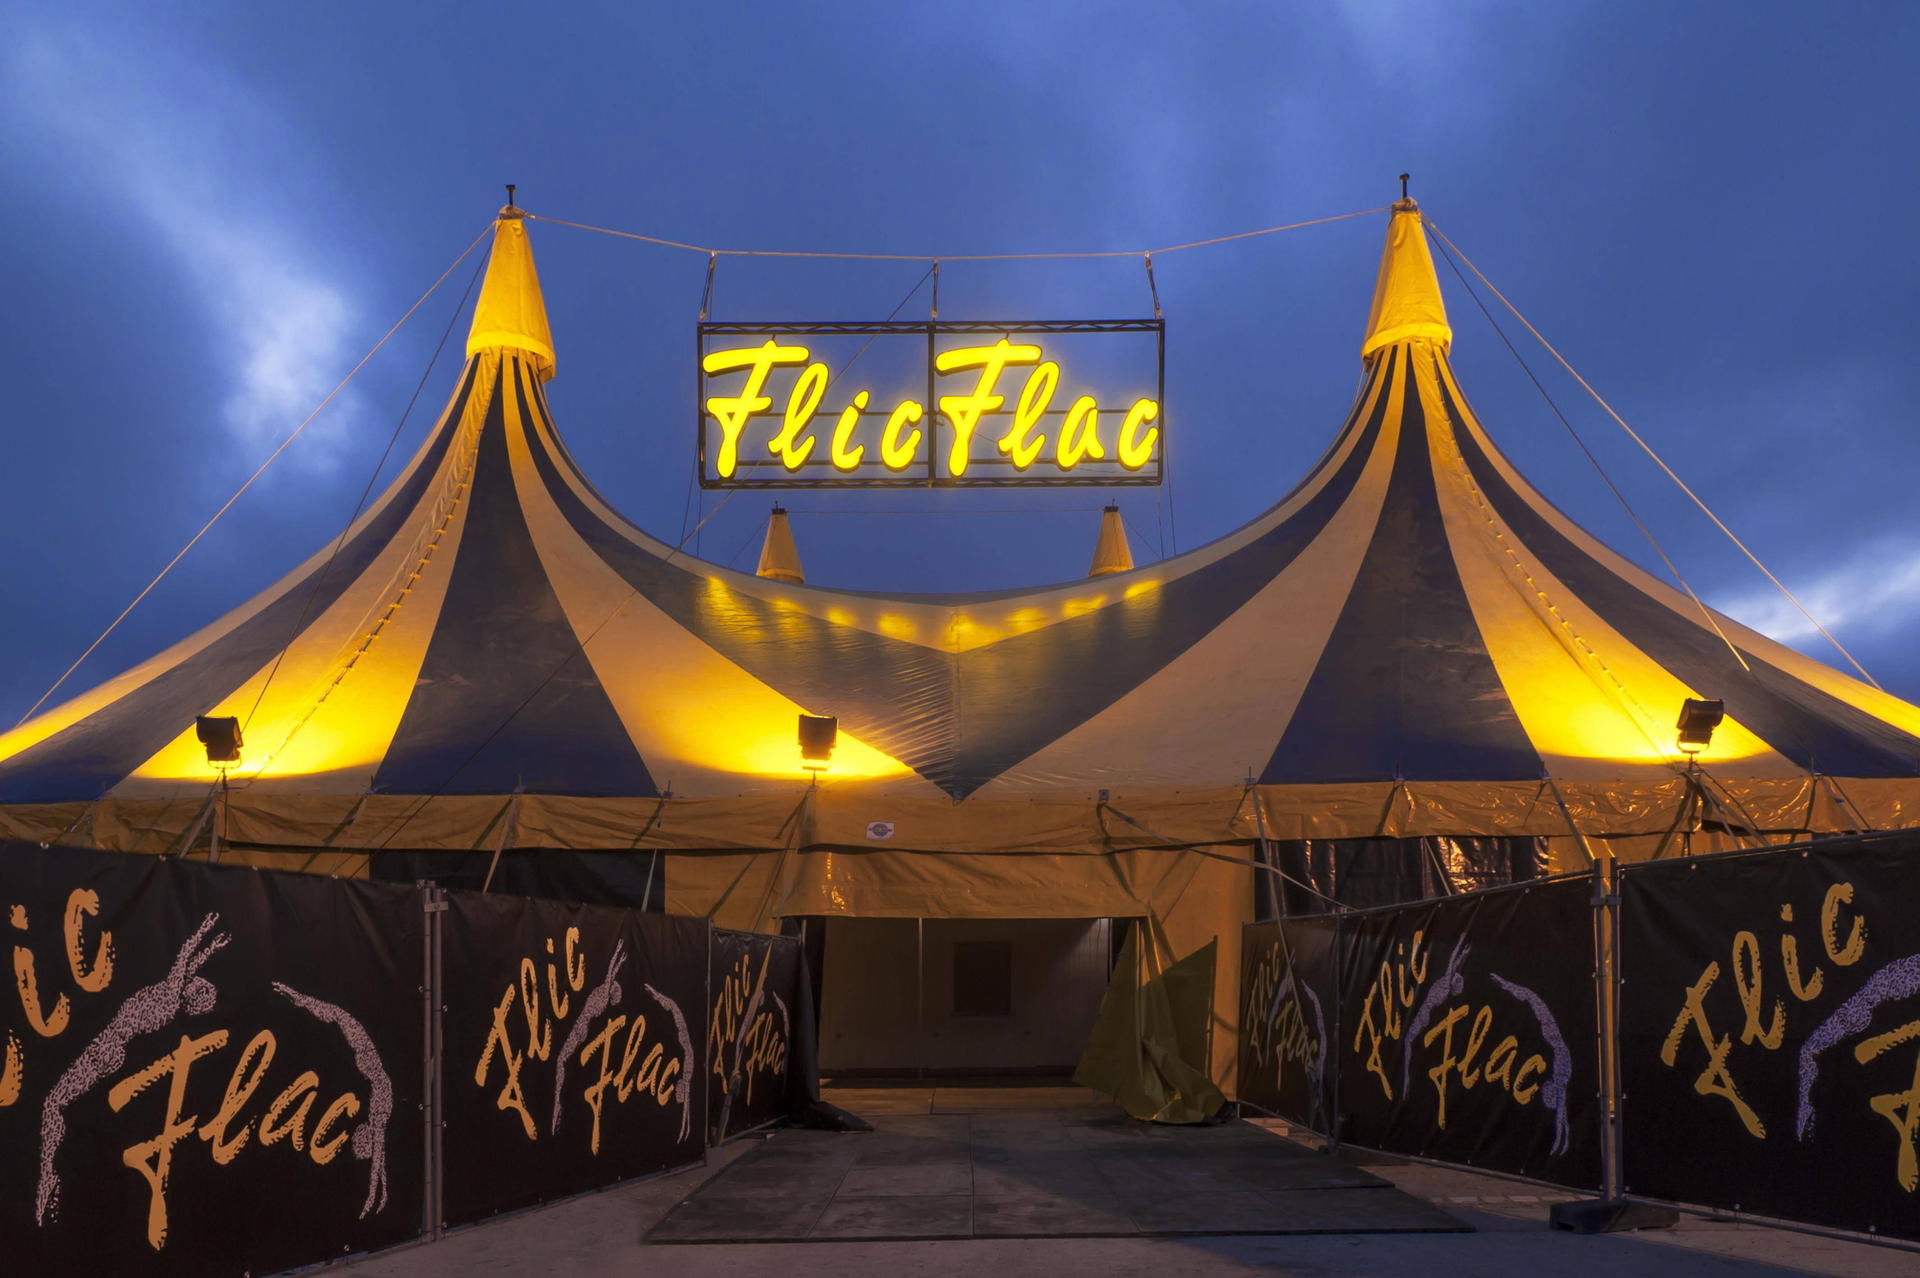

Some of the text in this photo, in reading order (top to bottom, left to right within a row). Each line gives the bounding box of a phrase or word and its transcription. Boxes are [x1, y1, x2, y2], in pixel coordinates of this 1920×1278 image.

[702, 338, 1158, 478] Flic Flac
[0, 888, 116, 1106] ic
[475, 926, 585, 1141] Flic
[708, 954, 750, 1094] Flic
[744, 1012, 785, 1107] Flac
[1246, 941, 1279, 1068] Flic
[1354, 930, 1428, 1101] Flic
[1424, 1004, 1547, 1130] Flac
[1660, 882, 1869, 1140] Flic
[108, 1029, 361, 1251] Flac
[580, 1015, 680, 1155] Flac
